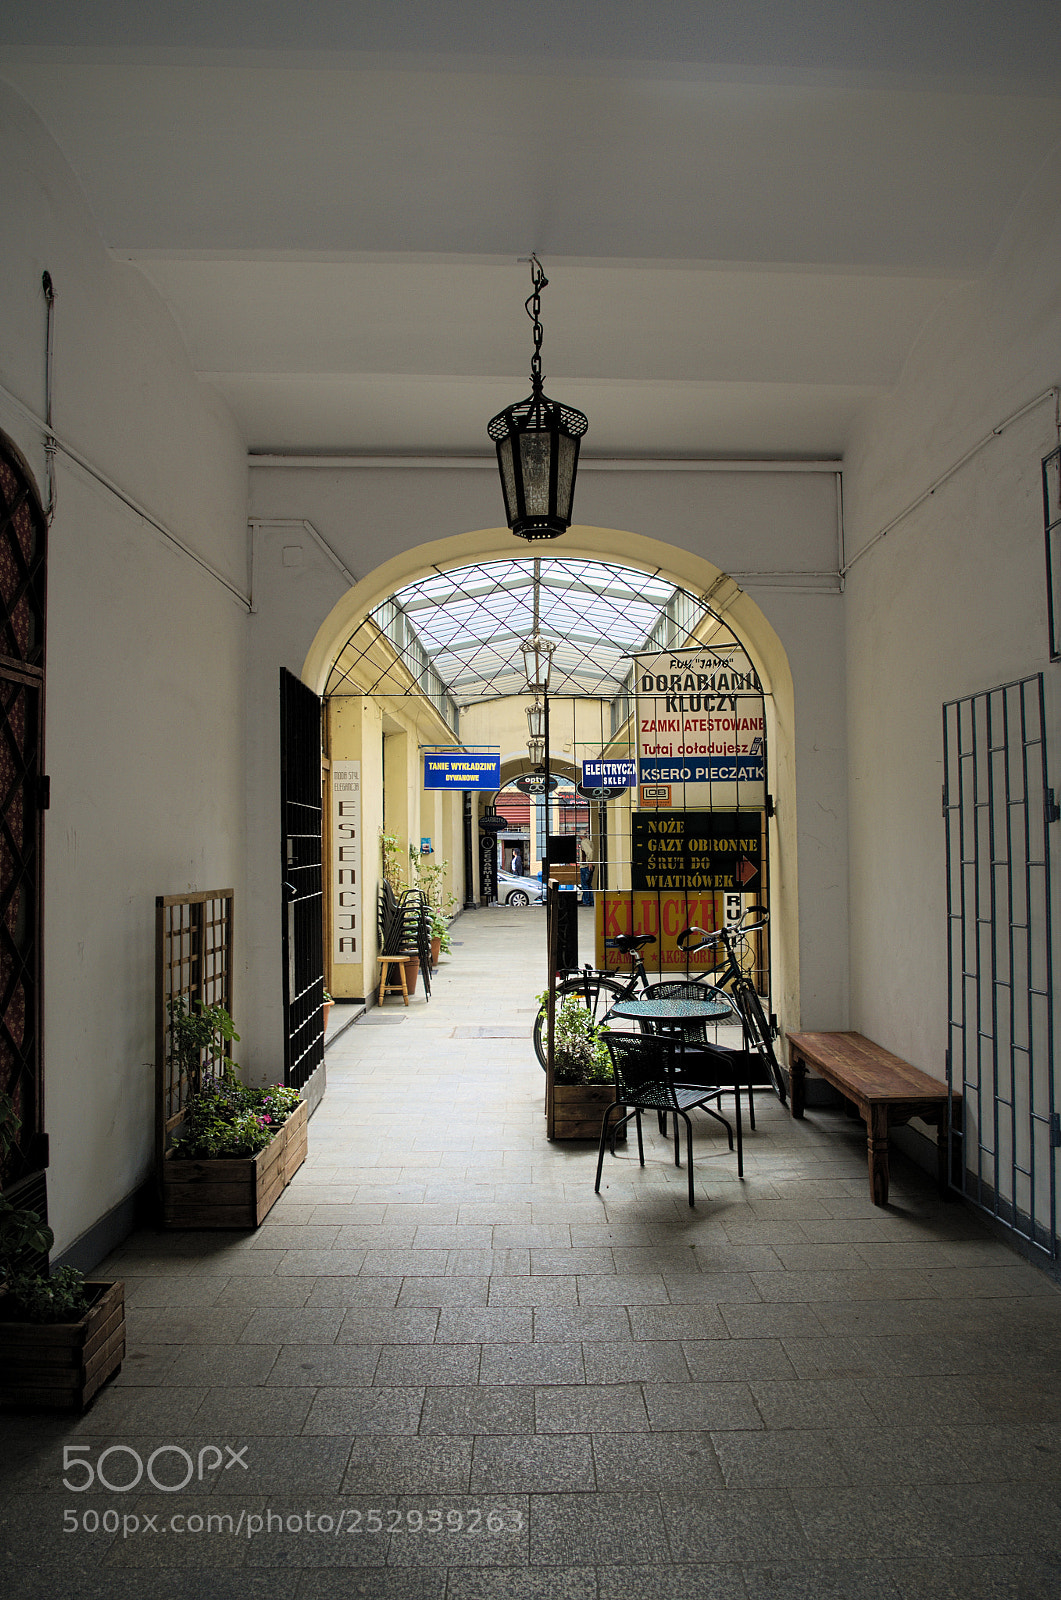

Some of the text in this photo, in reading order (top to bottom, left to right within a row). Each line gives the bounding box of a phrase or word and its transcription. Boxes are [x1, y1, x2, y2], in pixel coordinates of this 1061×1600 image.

[666, 695, 737, 712] KLUCZY
[641, 717, 764, 732] ZAMKI ATESTOWANE
[642, 742, 749, 757] Tutaj doładujesz
[428, 761, 497, 771] TANIE WYKŁADZINY
[445, 774, 480, 782] DYWANOWE
[524, 776, 547, 784] opty
[603, 776, 627, 785] SKLEP
[641, 768, 691, 780] KSERO
[647, 818, 685, 833] NOŻE
[647, 839, 758, 852] GAZY OBRONNE
[690, 856, 711, 870] DO
[645, 872, 734, 888] WIATRÓWEK
[600, 898, 719, 937] KLUCZE
[608, 949, 719, 965] ZAMI AKCESORIA
